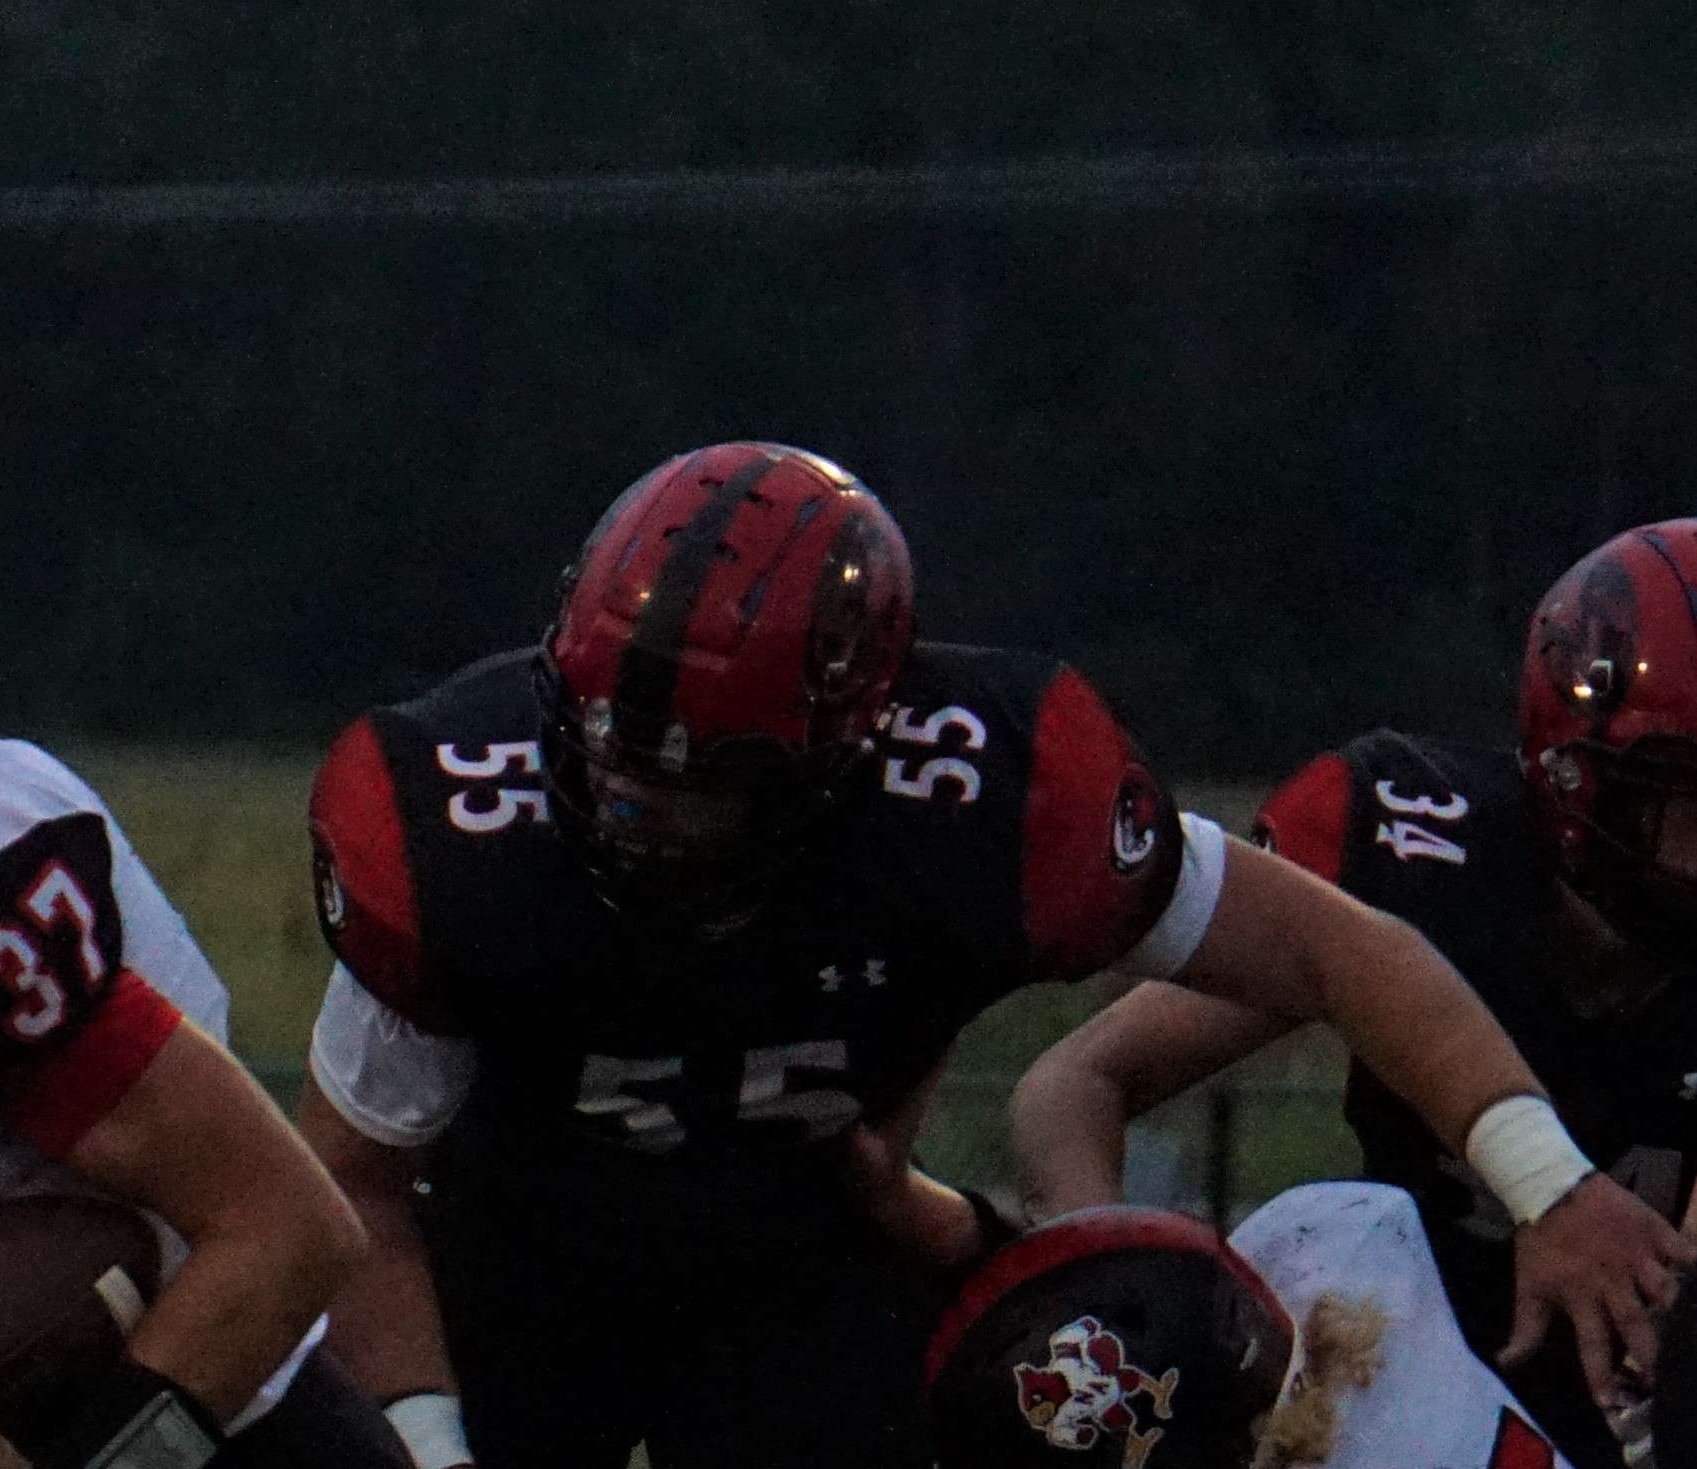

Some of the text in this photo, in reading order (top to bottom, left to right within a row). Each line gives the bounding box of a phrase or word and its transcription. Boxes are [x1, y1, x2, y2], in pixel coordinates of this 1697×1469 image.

[434, 739, 552, 834] 55
[884, 703, 988, 804] 55
[1374, 778, 1470, 865] 34
[572, 1039, 863, 1154] 55
